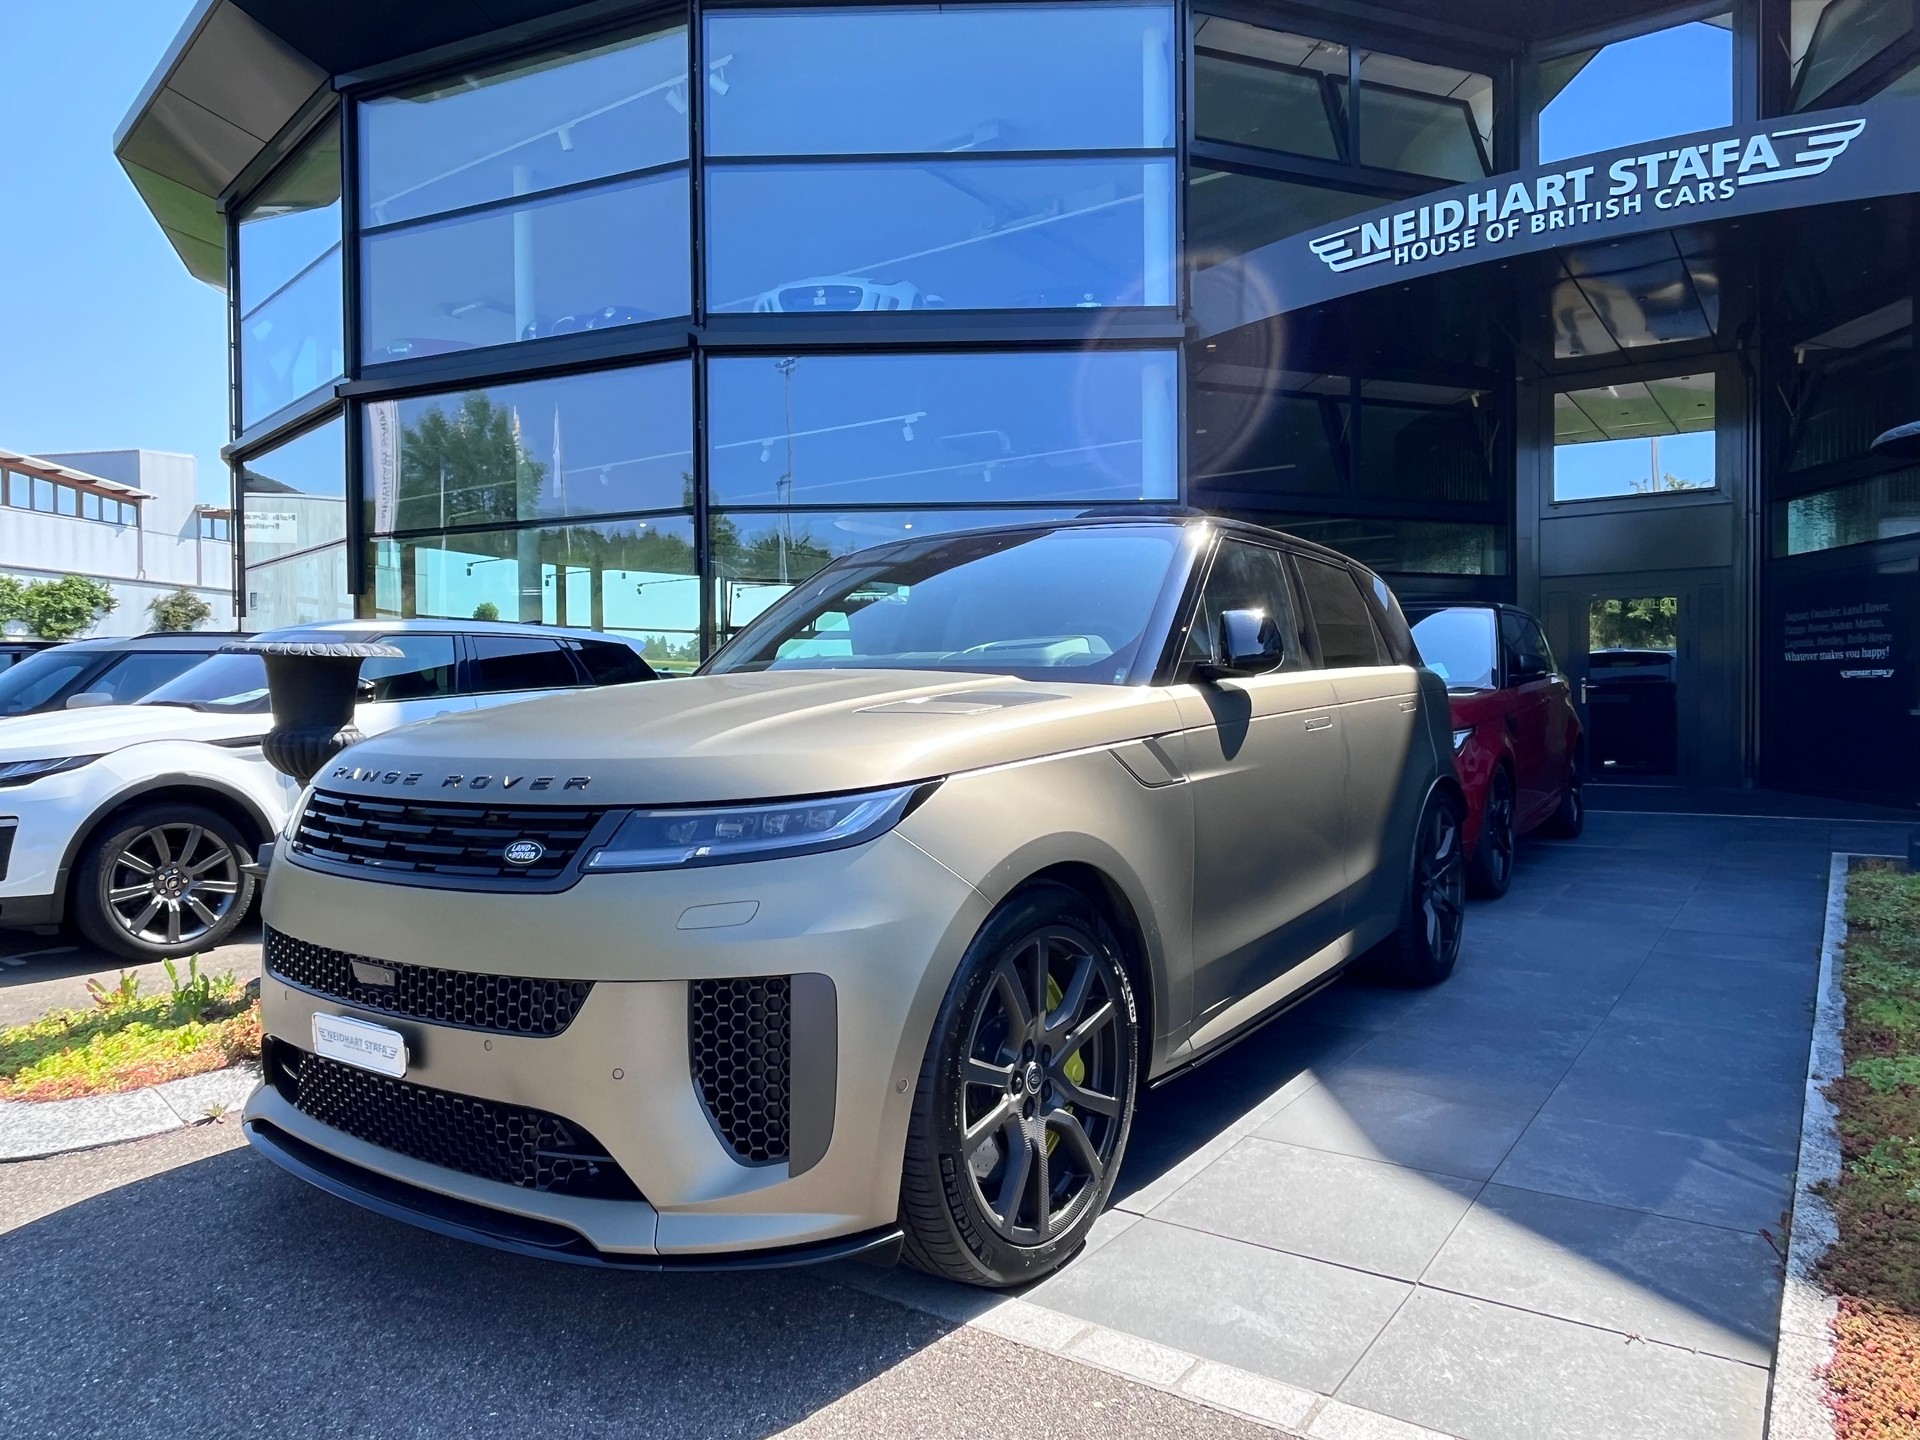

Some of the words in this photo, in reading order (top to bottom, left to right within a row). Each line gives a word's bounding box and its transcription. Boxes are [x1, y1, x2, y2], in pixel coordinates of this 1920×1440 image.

[1361, 166, 1594, 255] NEIDHART
[1608, 134, 1780, 196] STÄFA
[1394, 229, 1476, 266] HOUSE
[1486, 219, 1520, 243] OF
[1531, 194, 1642, 234] BRITISH
[1655, 179, 1736, 209] CARS
[1784, 651, 1819, 662] Whatever
[1819, 649, 1844, 660] makes
[1845, 649, 1860, 661] you
[1861, 645, 1890, 660] happy!
[333, 766, 423, 786] RANGE
[442, 774, 592, 791] ROVER
[511, 851, 536, 859] ROVER
[327, 1031, 363, 1049] NEIDHART
[941, 1157, 985, 1251] MICHELIN
